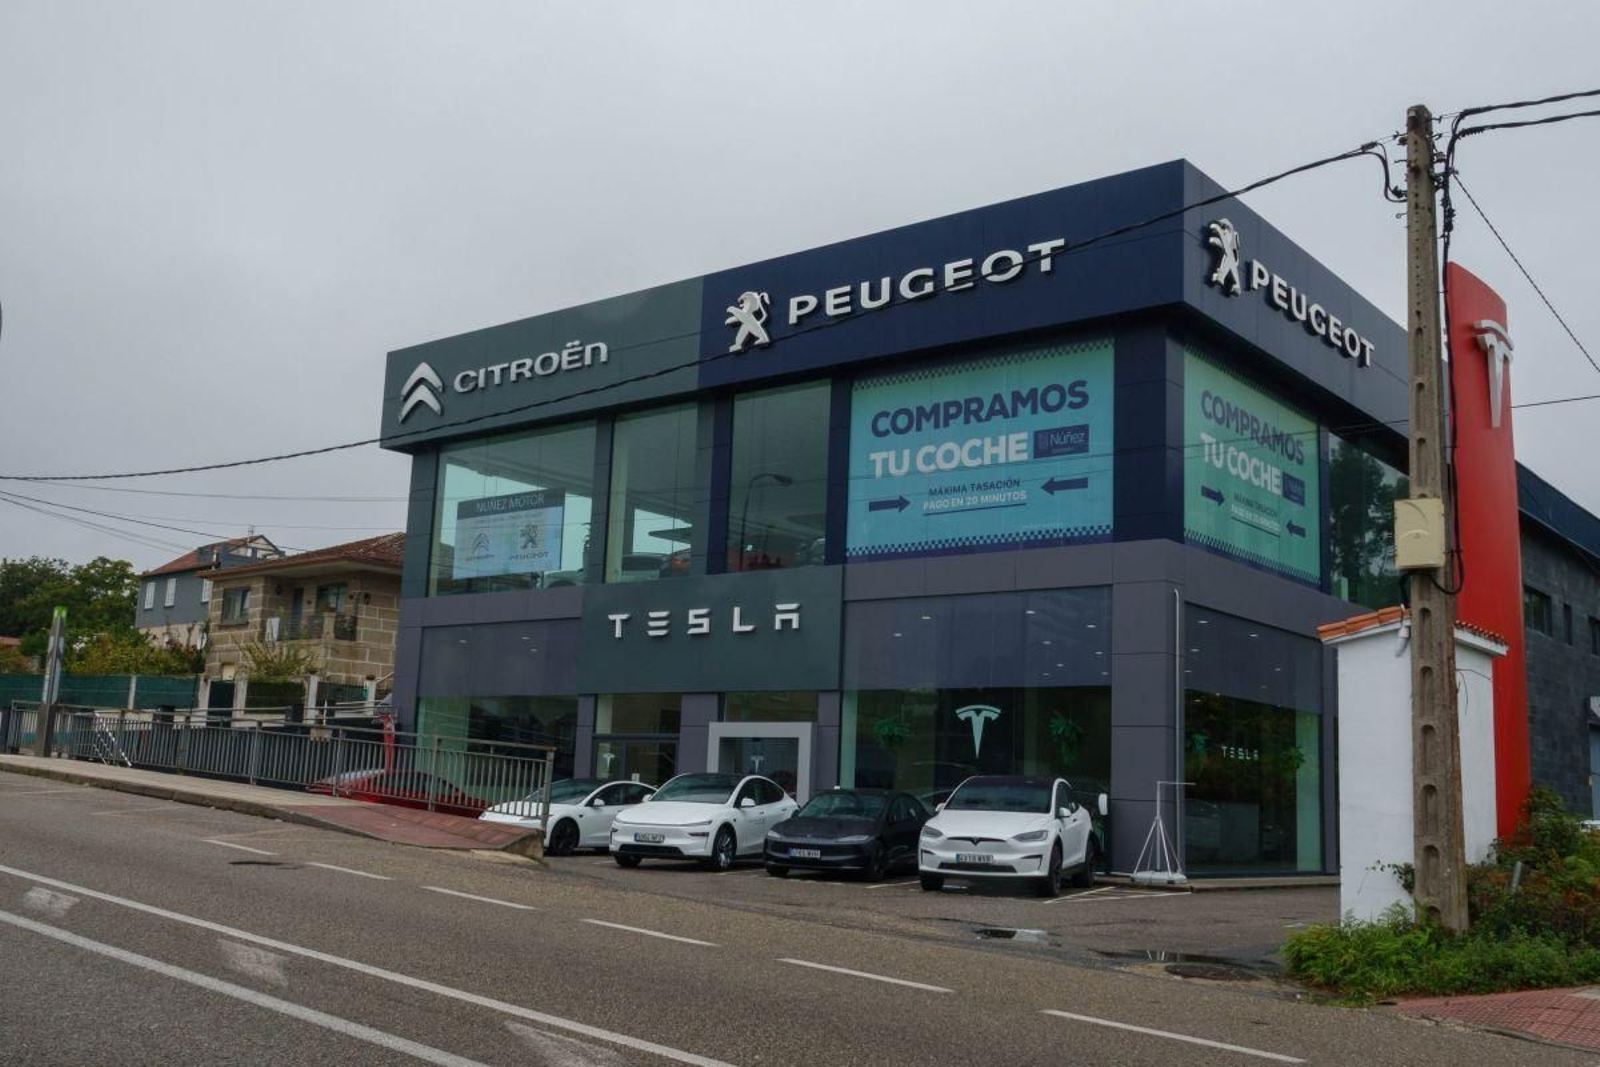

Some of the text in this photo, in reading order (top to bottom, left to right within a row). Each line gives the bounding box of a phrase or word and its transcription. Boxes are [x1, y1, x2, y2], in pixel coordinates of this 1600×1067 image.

[788, 238, 1065, 325] PEUGEOT
[1251, 259, 1375, 366] PEUGEOT
[871, 379, 1090, 438] COMPRAMOS
[1201, 390, 1304, 465] COMPRAMOS
[869, 431, 1029, 480] TU COCHE
[1200, 432, 1225, 469] TU
[1226, 446, 1282, 496] COCHE
[923, 490, 1027, 511] PAGO EN 20 MINUTOS
[608, 603, 800, 639] TESLA
[1221, 746, 1259, 761] TESLA
